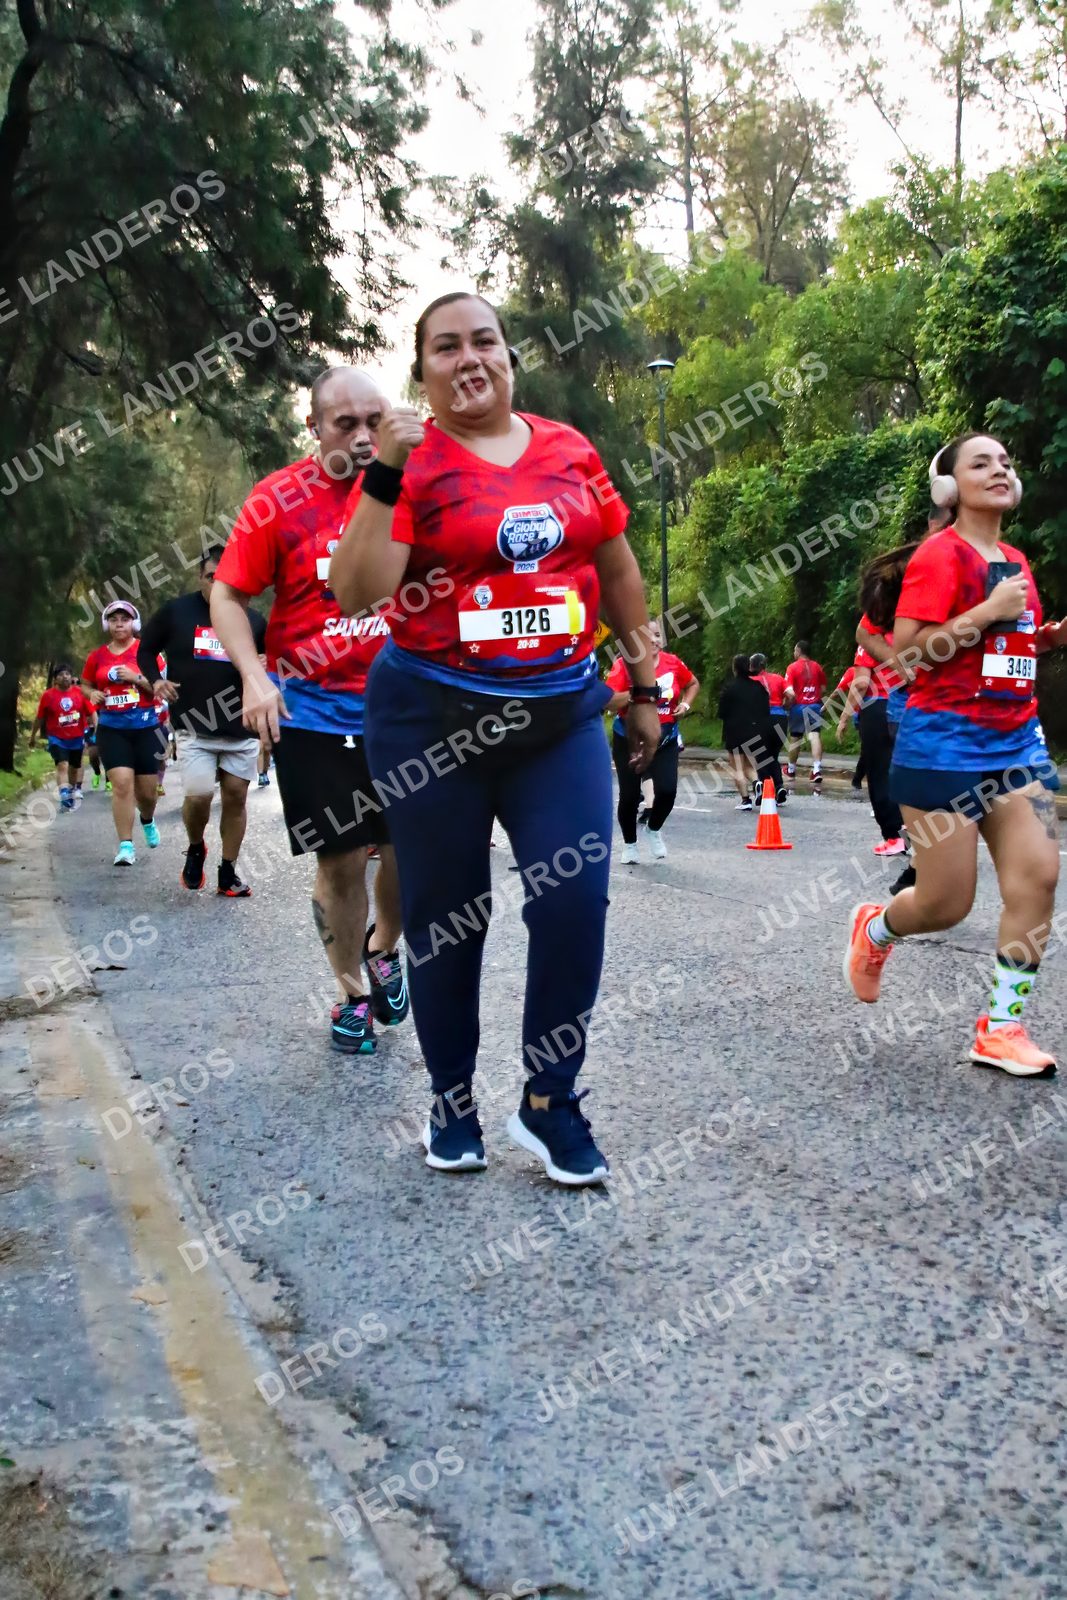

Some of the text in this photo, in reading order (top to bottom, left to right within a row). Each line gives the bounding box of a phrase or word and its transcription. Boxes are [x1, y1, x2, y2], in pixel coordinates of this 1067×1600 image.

[511, 509, 546, 519] BIMBO
[513, 520, 546, 533] Global
[507, 531, 535, 544] Race
[515, 563, 536, 572] 2026
[322, 615, 392, 637] SANTIA
[501, 607, 551, 636] 3126
[1007, 657, 1033, 678] 3489
[112, 695, 129, 705] 1934
